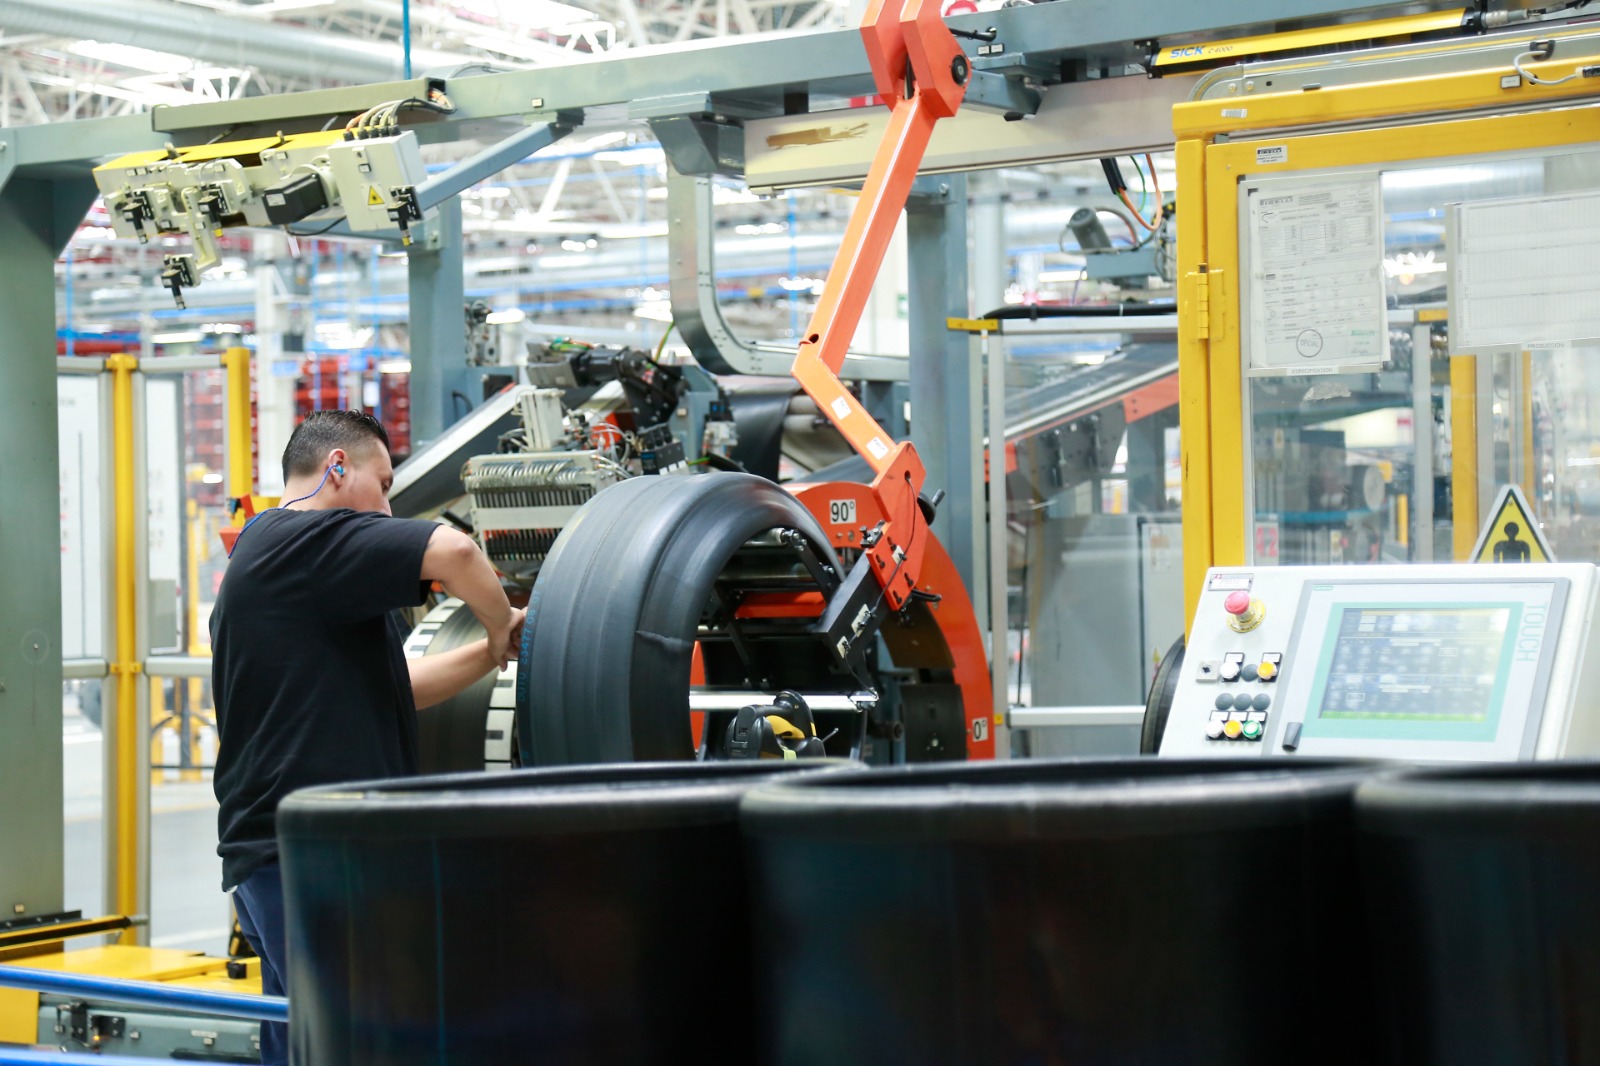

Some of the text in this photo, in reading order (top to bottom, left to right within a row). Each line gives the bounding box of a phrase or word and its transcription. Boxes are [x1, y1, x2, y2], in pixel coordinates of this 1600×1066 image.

[1170, 46, 1206, 58] SICK
[831, 501, 855, 522] 90°
[1516, 601, 1548, 662] TOUCH
[973, 719, 987, 740] 0°
